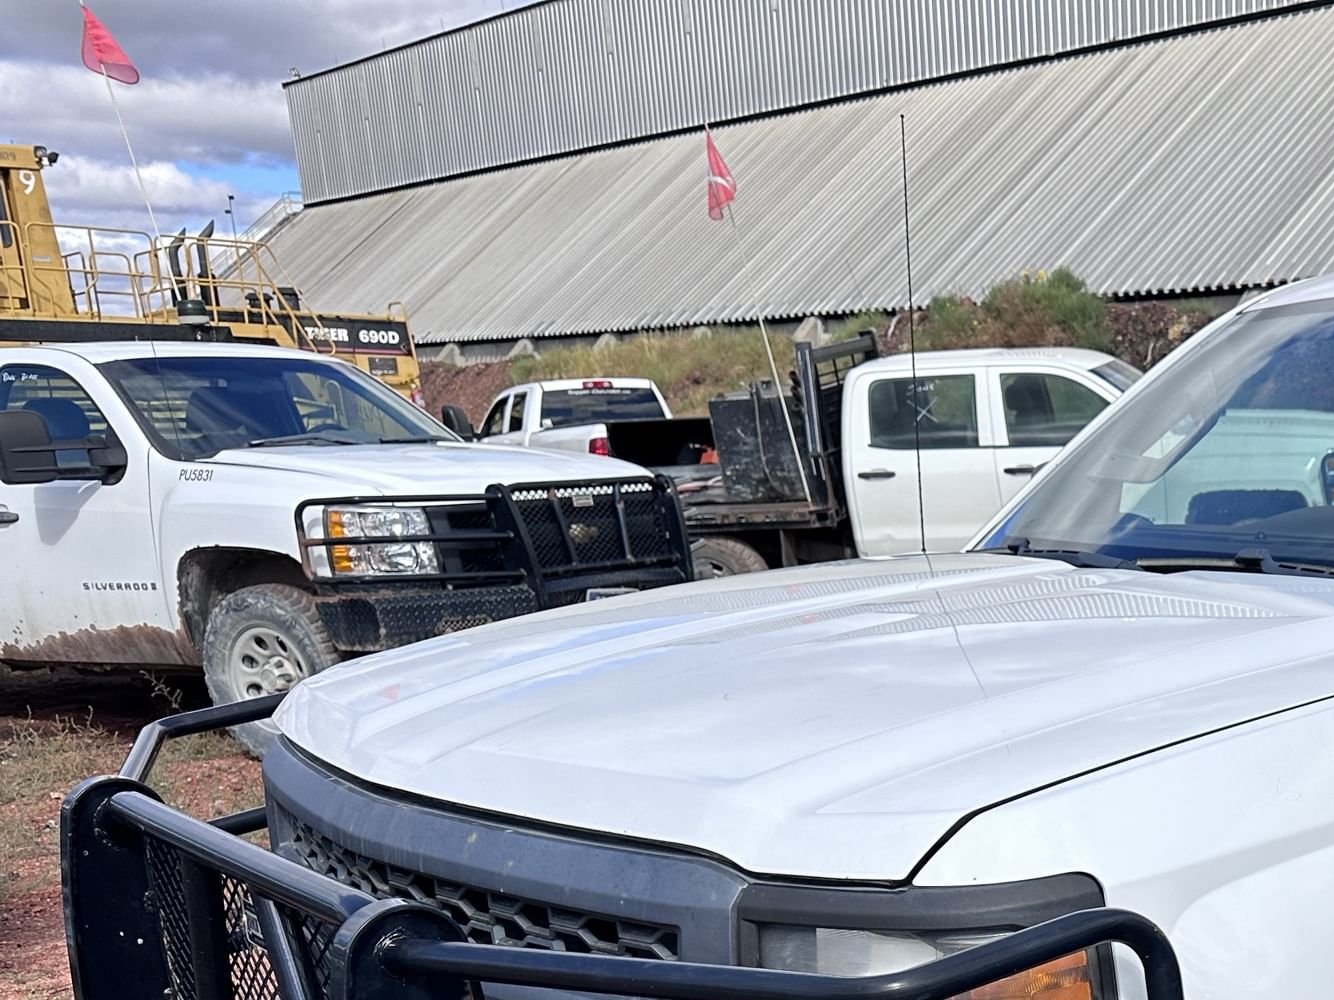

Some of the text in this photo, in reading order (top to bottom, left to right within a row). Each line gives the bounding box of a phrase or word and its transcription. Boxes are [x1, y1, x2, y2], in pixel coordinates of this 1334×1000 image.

[19, 170, 35, 195] 9
[358, 329, 400, 344] 690D
[178, 468, 214, 482] PU5831
[82, 582, 149, 591] SILVERADO
